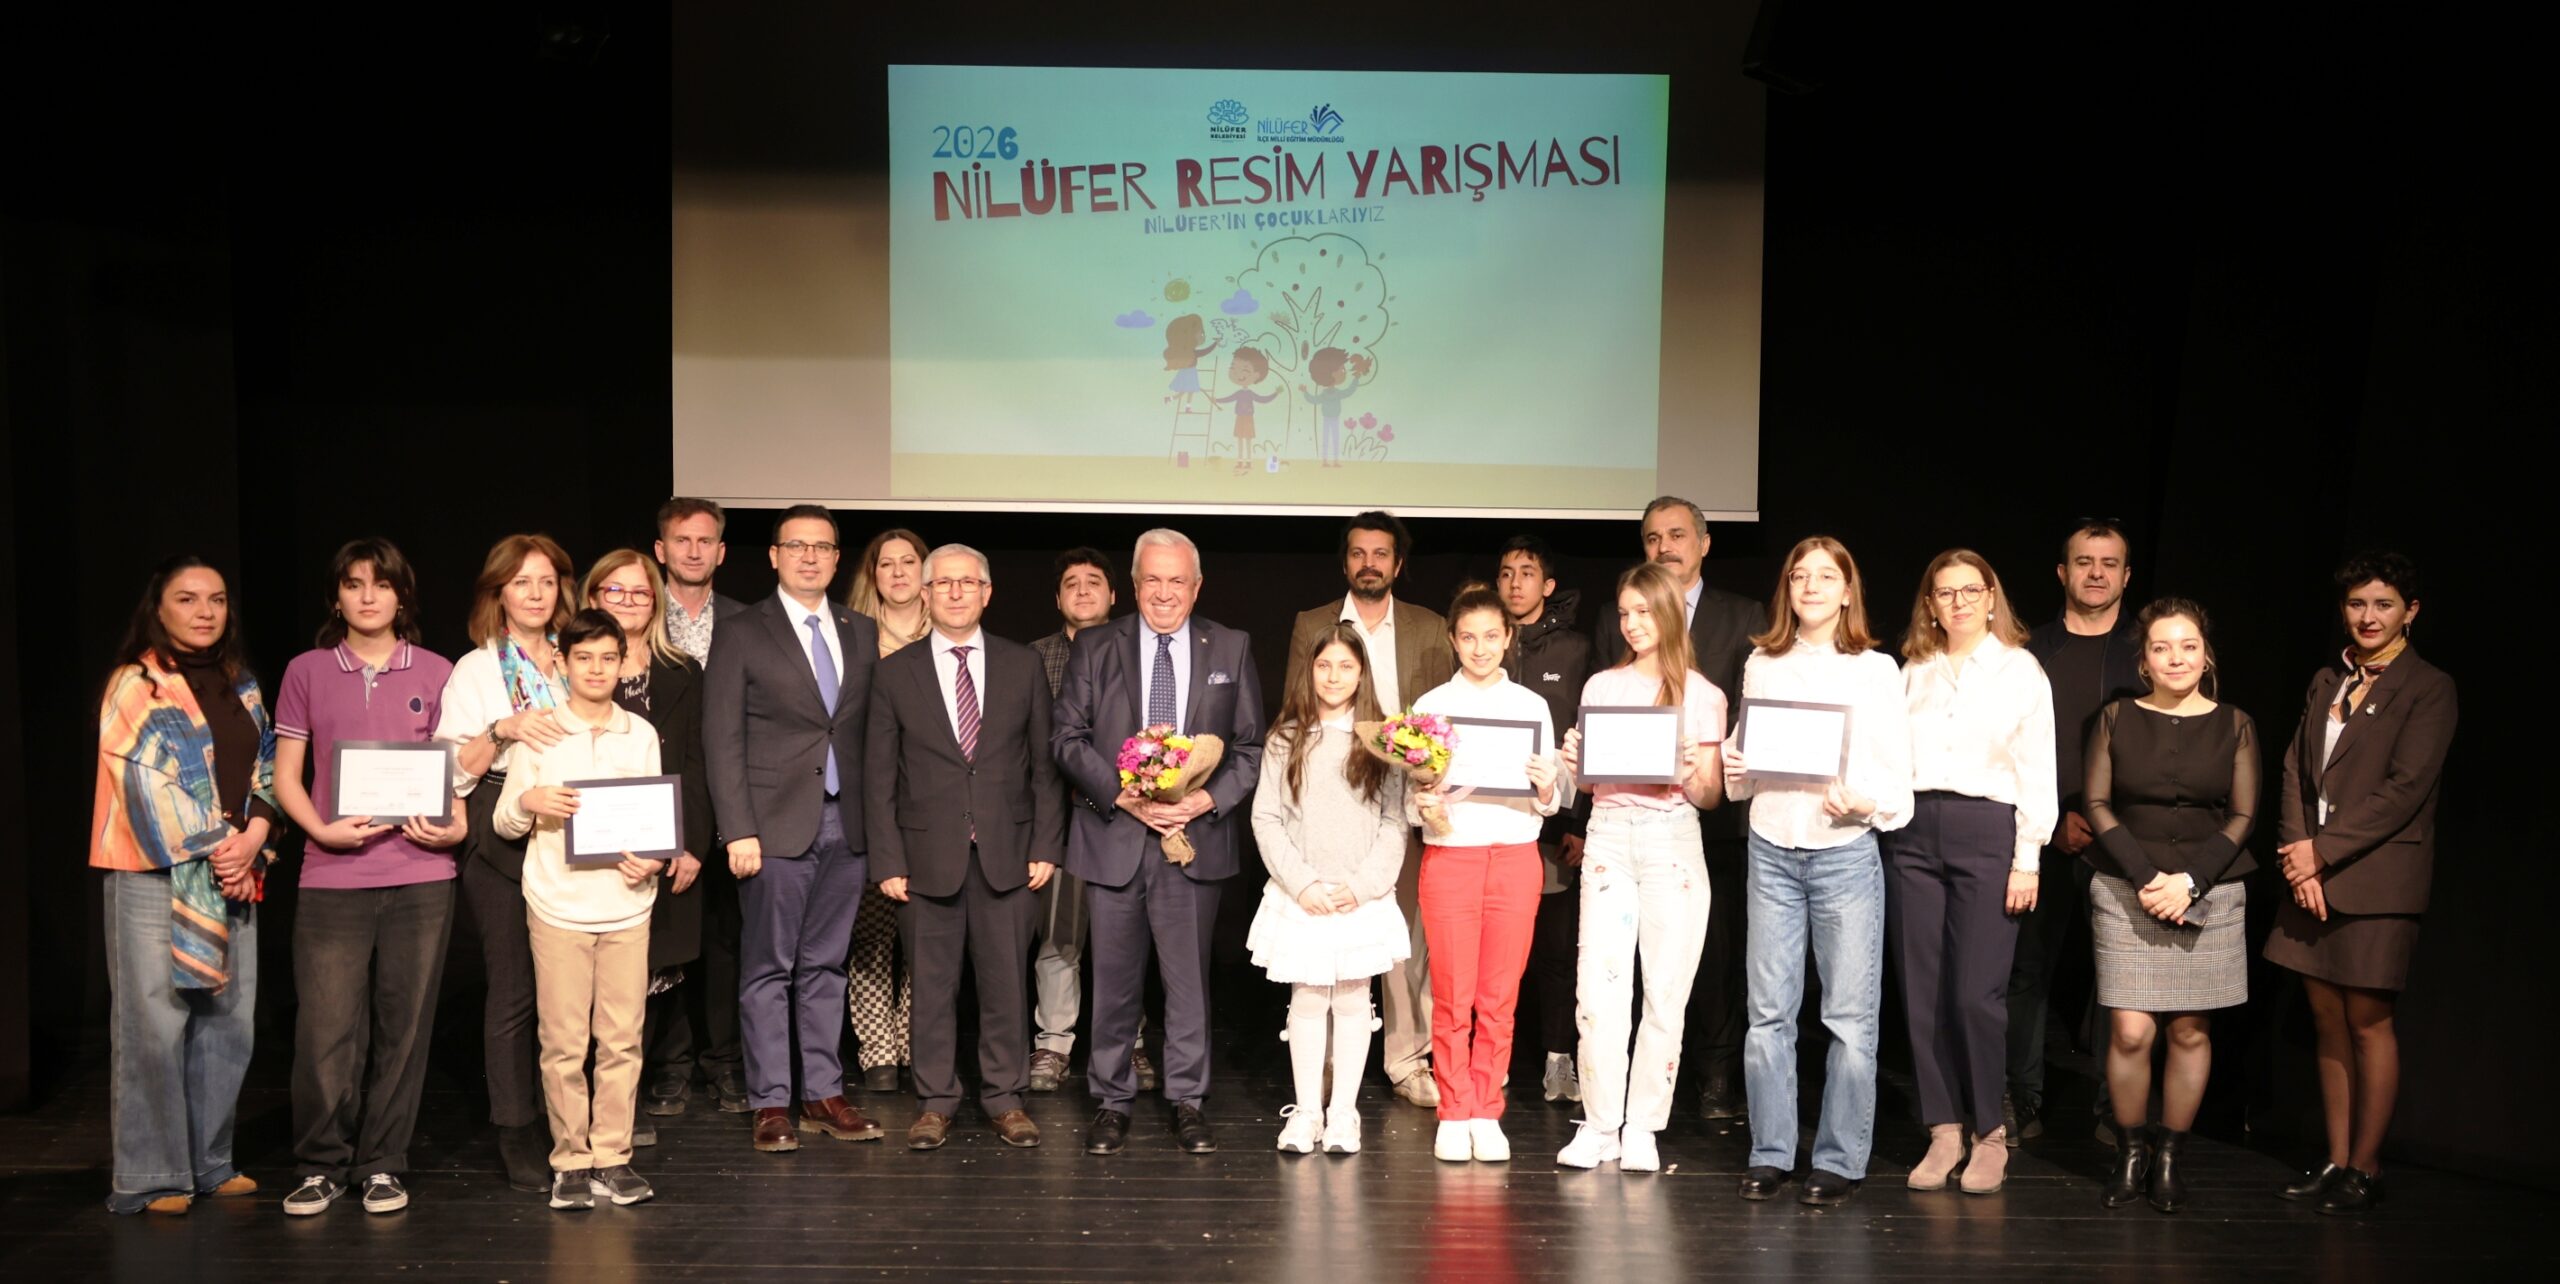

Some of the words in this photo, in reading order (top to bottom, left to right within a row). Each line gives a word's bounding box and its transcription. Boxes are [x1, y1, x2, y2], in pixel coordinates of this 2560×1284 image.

[1257, 118, 1308, 135] NİLÜFER
[932, 124, 1019, 160] 2026
[933, 158, 1157, 221] NİLÜFER
[1176, 145, 1326, 209] RESİM
[1346, 134, 1621, 202] YARIŞMASI
[1254, 206, 1386, 231] ÇOCUKLARIYIZ
